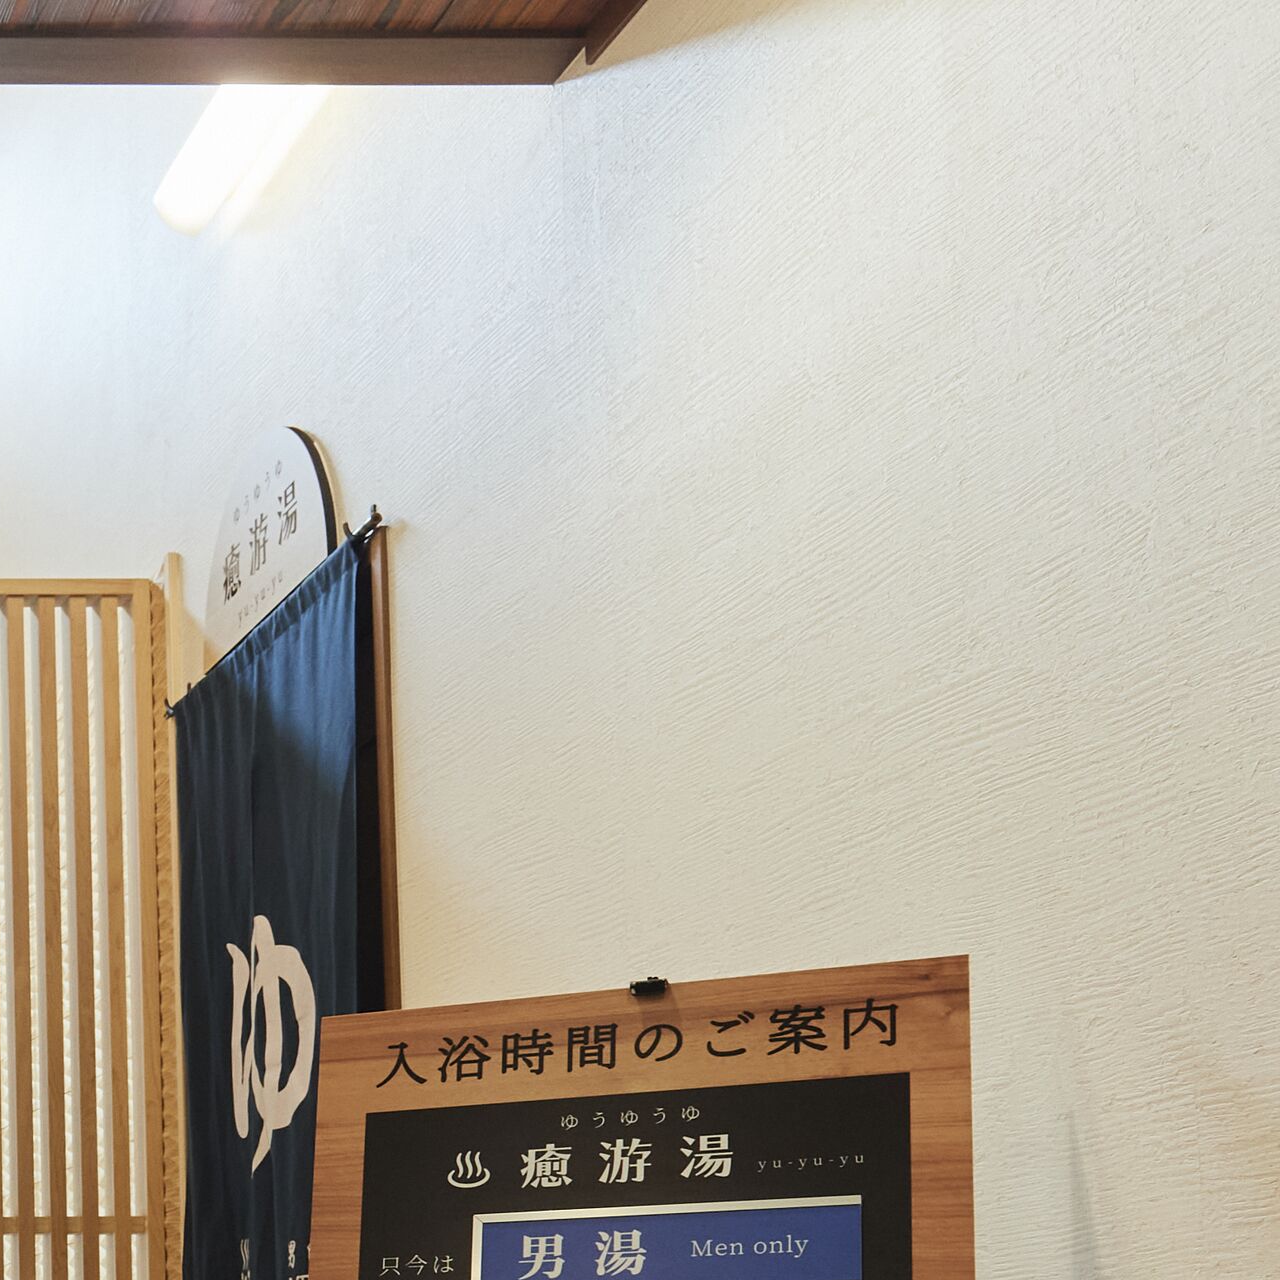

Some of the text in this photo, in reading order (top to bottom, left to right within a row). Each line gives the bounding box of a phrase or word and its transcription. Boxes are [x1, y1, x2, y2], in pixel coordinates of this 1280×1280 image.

[223, 480, 298, 605] 癒游湯
[226, 915, 316, 1179] ゆ
[376, 998, 899, 1088] 入浴時間のご案内
[560, 1105, 701, 1131] ゆうゆうゆ
[520, 1134, 865, 1189] 癒游湯 yu-yu-yu
[379, 1229, 809, 1280] 只今は 男湯 Men only
